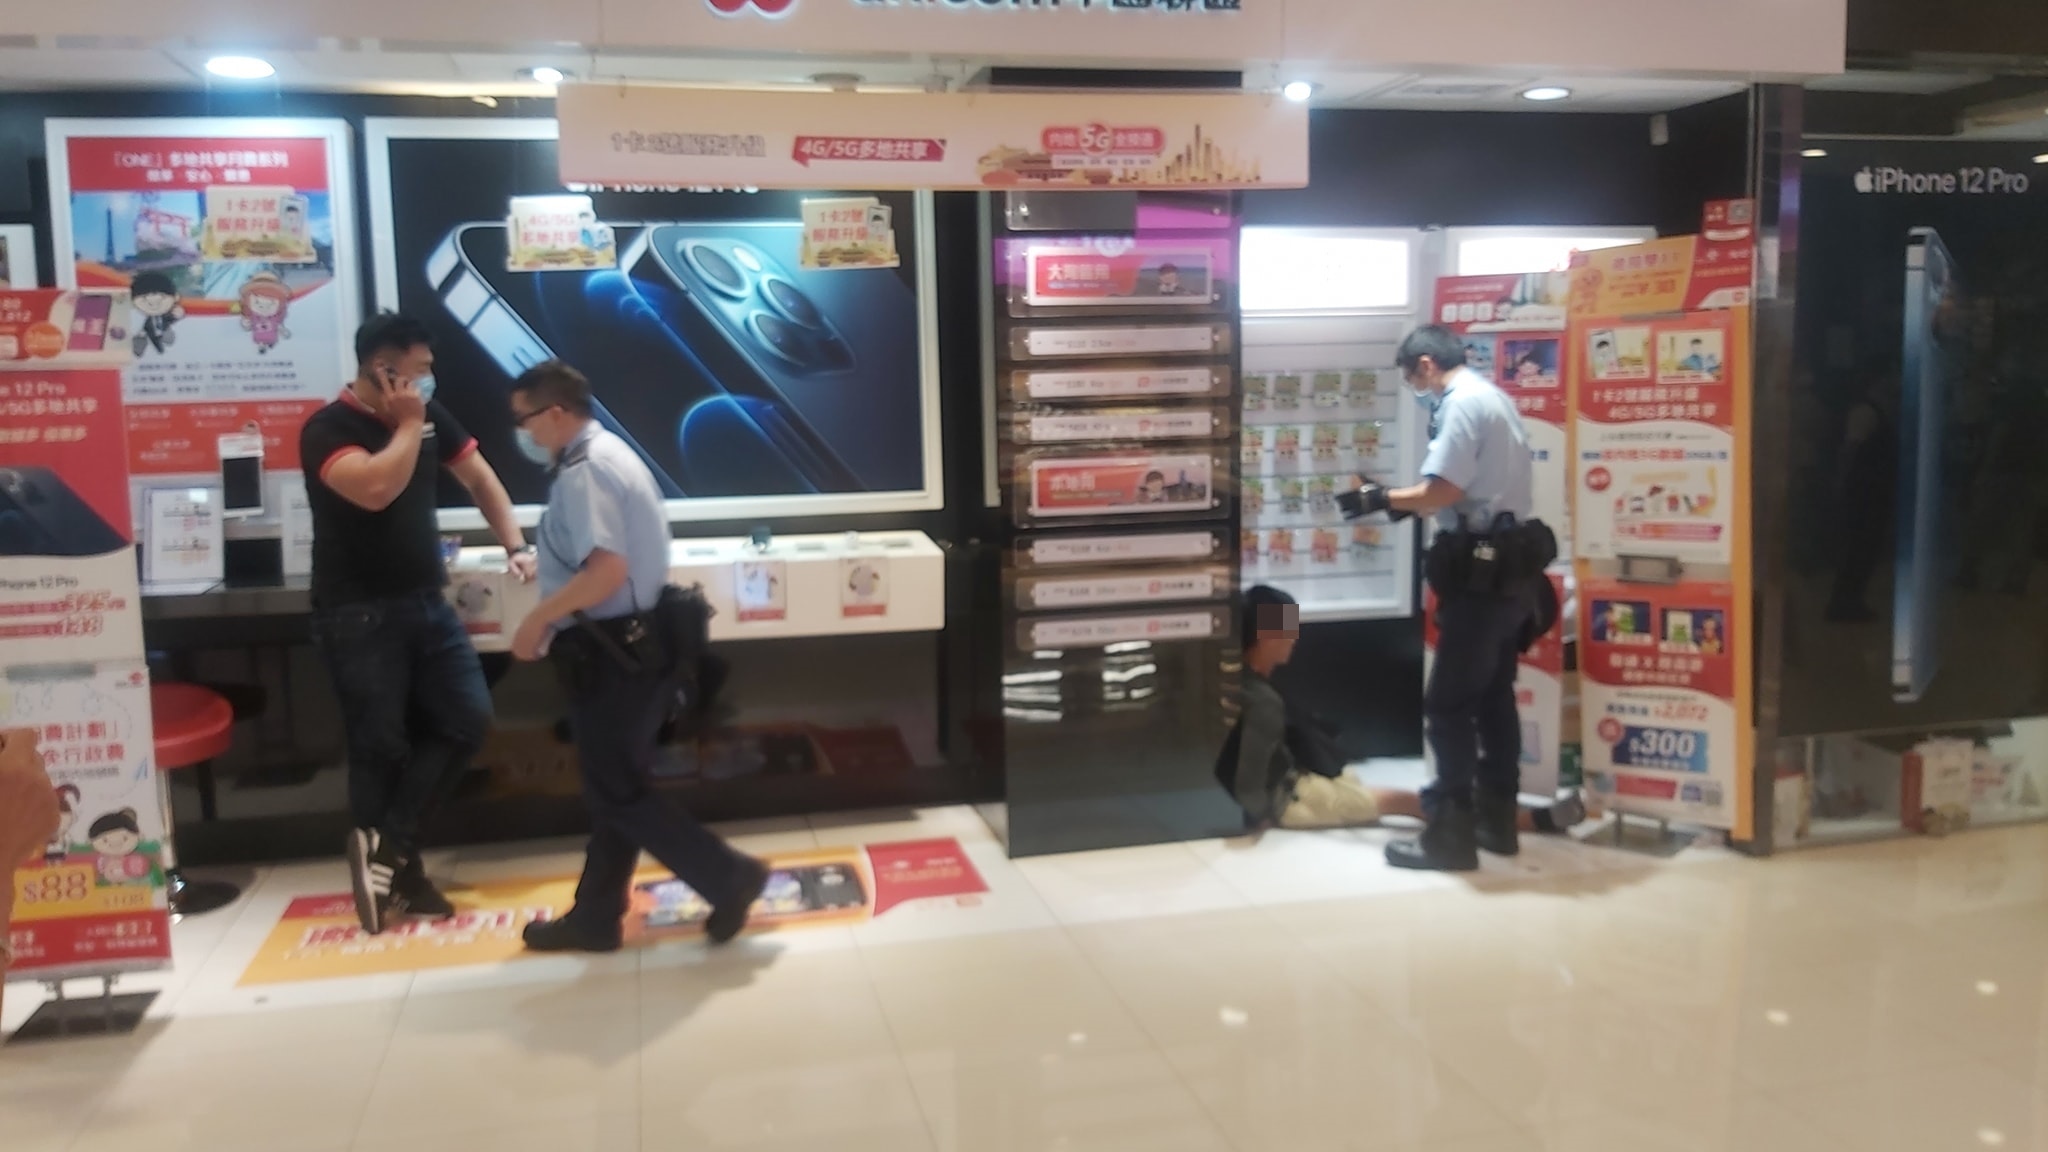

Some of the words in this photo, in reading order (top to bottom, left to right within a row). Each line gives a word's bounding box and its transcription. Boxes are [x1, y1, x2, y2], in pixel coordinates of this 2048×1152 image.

[1874, 166, 1957, 193] iPhone
[1958, 167, 1984, 193] 12
[1987, 167, 2029, 194] Pro
[14, 381, 33, 396] 12
[37, 381, 67, 396] Pro
[40, 577, 54, 589] 12
[55, 576, 79, 588] Pro
[1629, 729, 1696, 758] $300
[23, 871, 87, 904] $88
